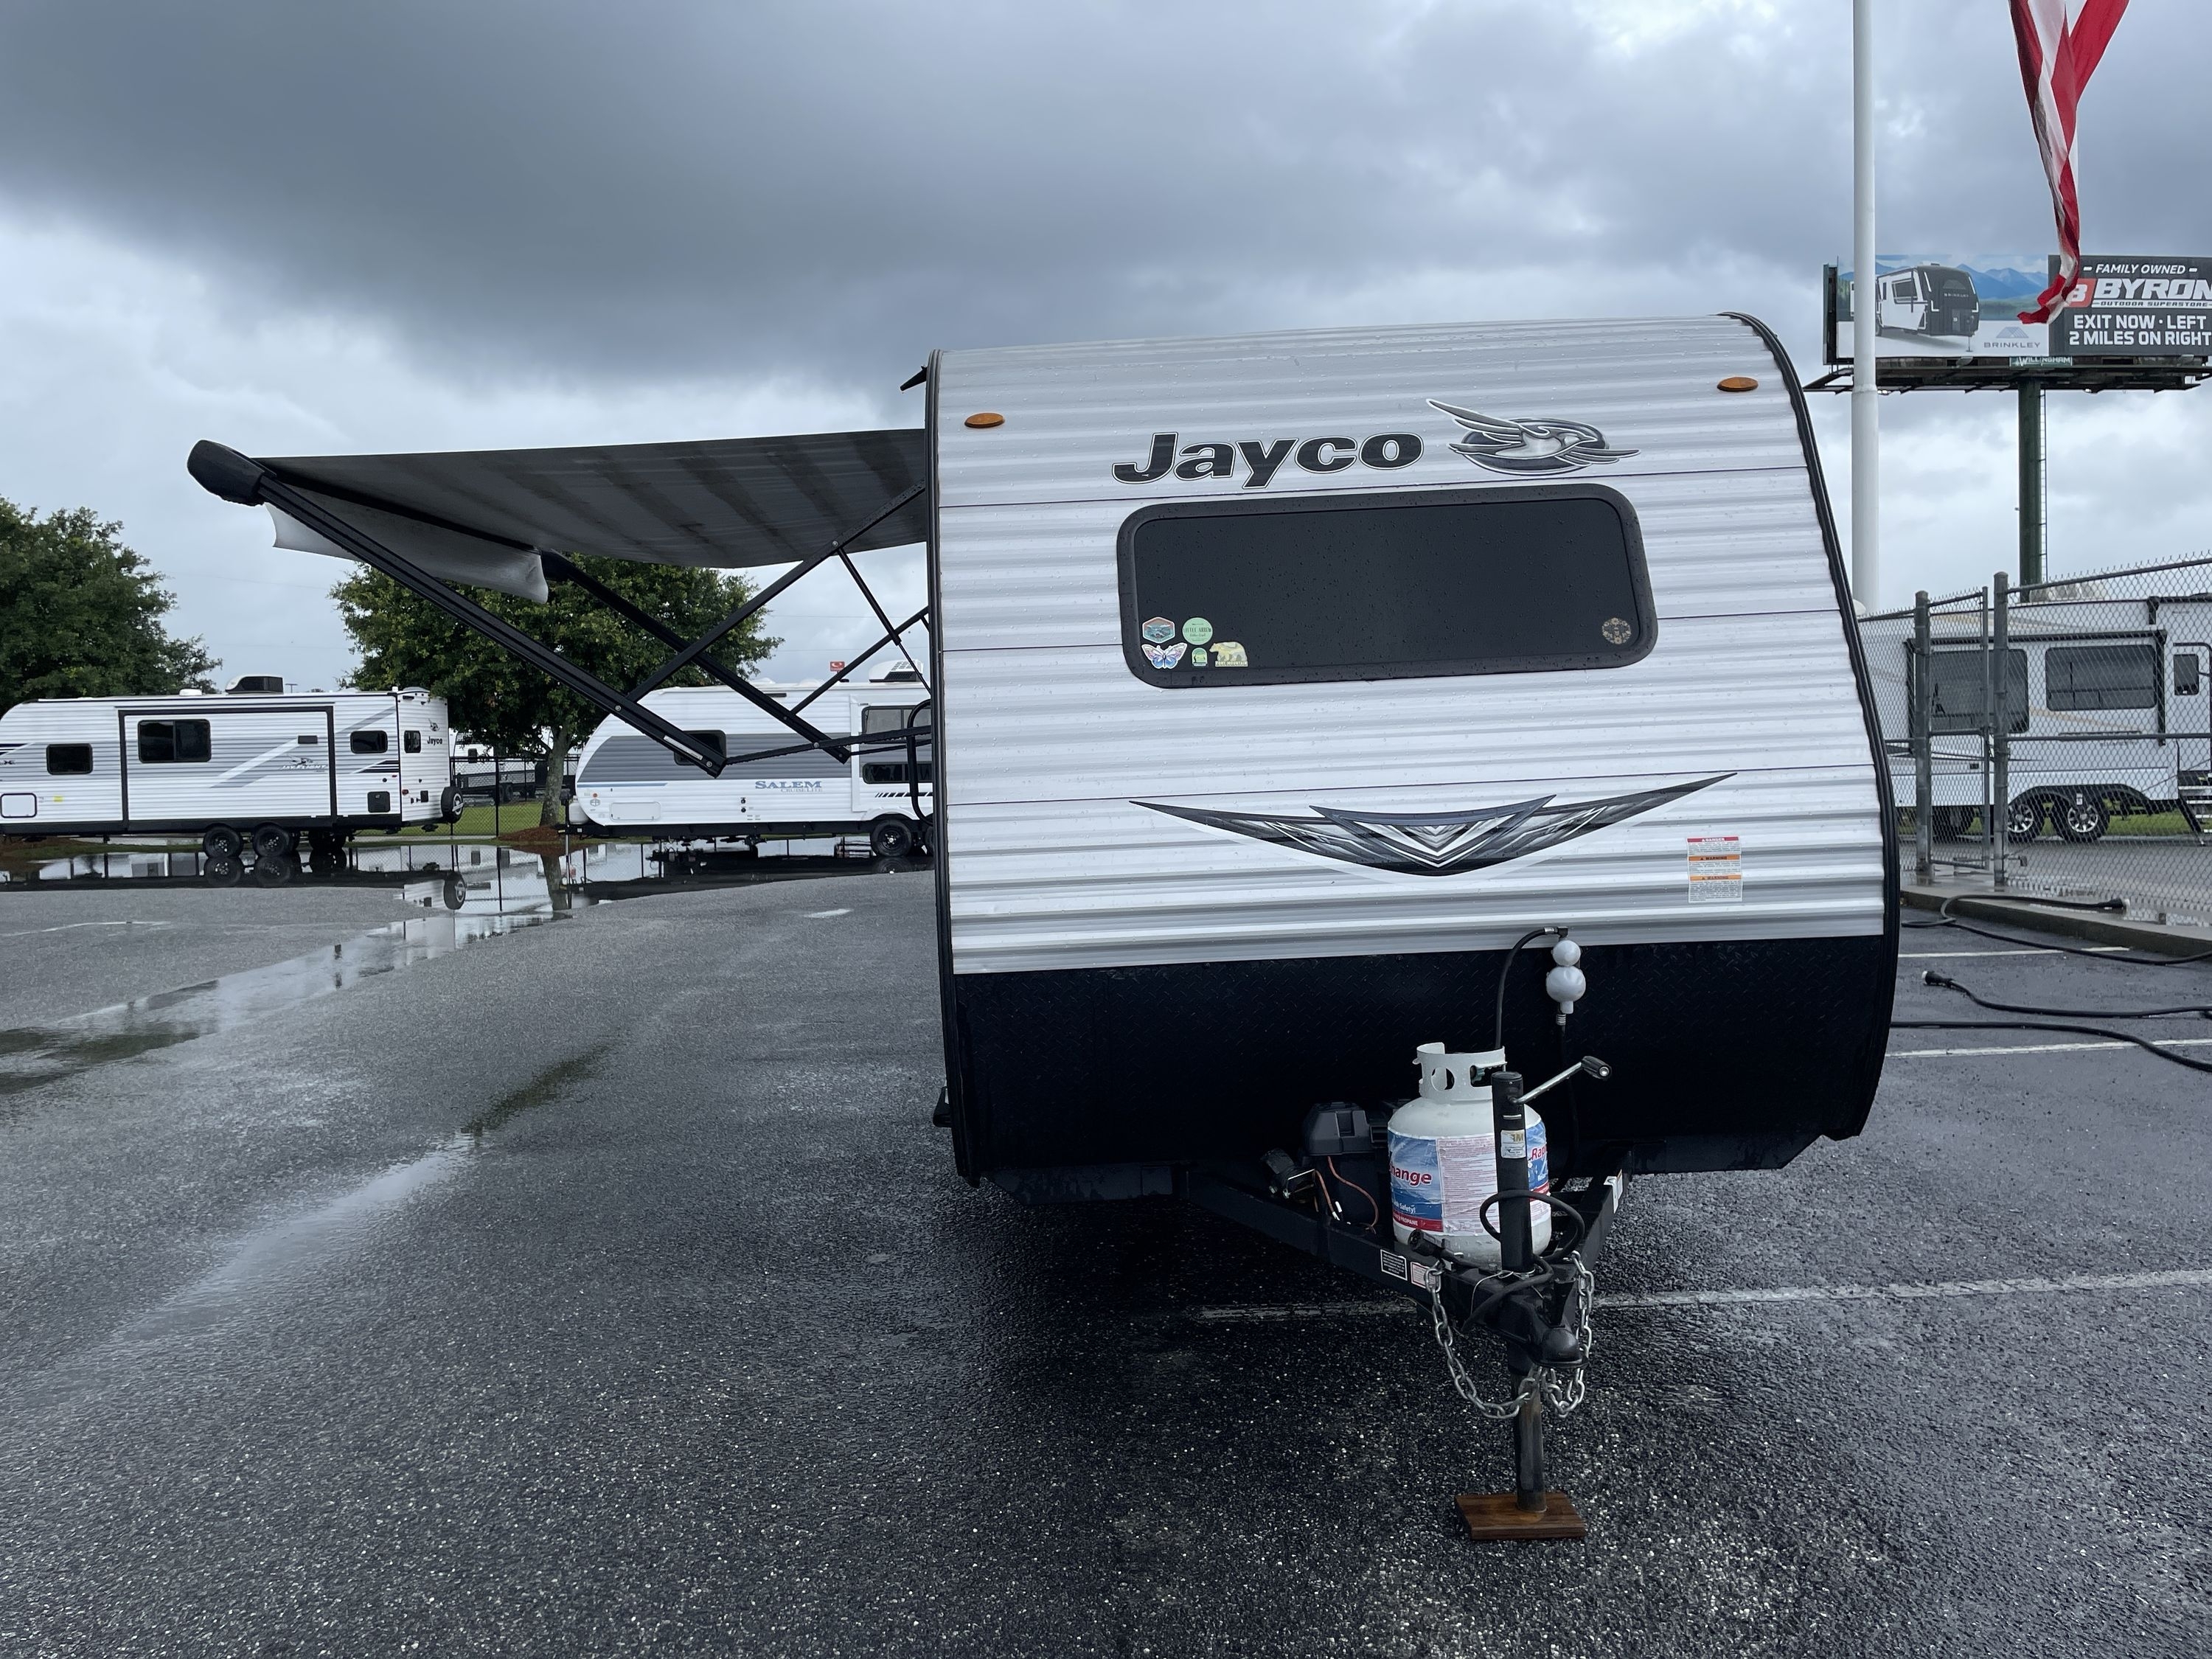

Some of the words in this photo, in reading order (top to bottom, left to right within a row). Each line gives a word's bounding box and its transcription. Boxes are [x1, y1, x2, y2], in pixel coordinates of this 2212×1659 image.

[2096, 264, 2138, 274] FAMILY
[2140, 264, 2185, 274] OWNED
[2073, 315, 2112, 329] EXIT
[2115, 315, 2155, 330] NOW
[2166, 315, 2207, 330] LEFT
[2069, 331, 2080, 345] 2
[2083, 331, 2135, 345] MILES
[2138, 331, 2161, 345] ON
[2165, 331, 2212, 346] RIGHT
[2016, 356, 2071, 366] WILLINGHAM
[1112, 432, 1425, 490] Jayco
[427, 736, 443, 745] Jayco
[754, 781, 822, 789] SALEM
